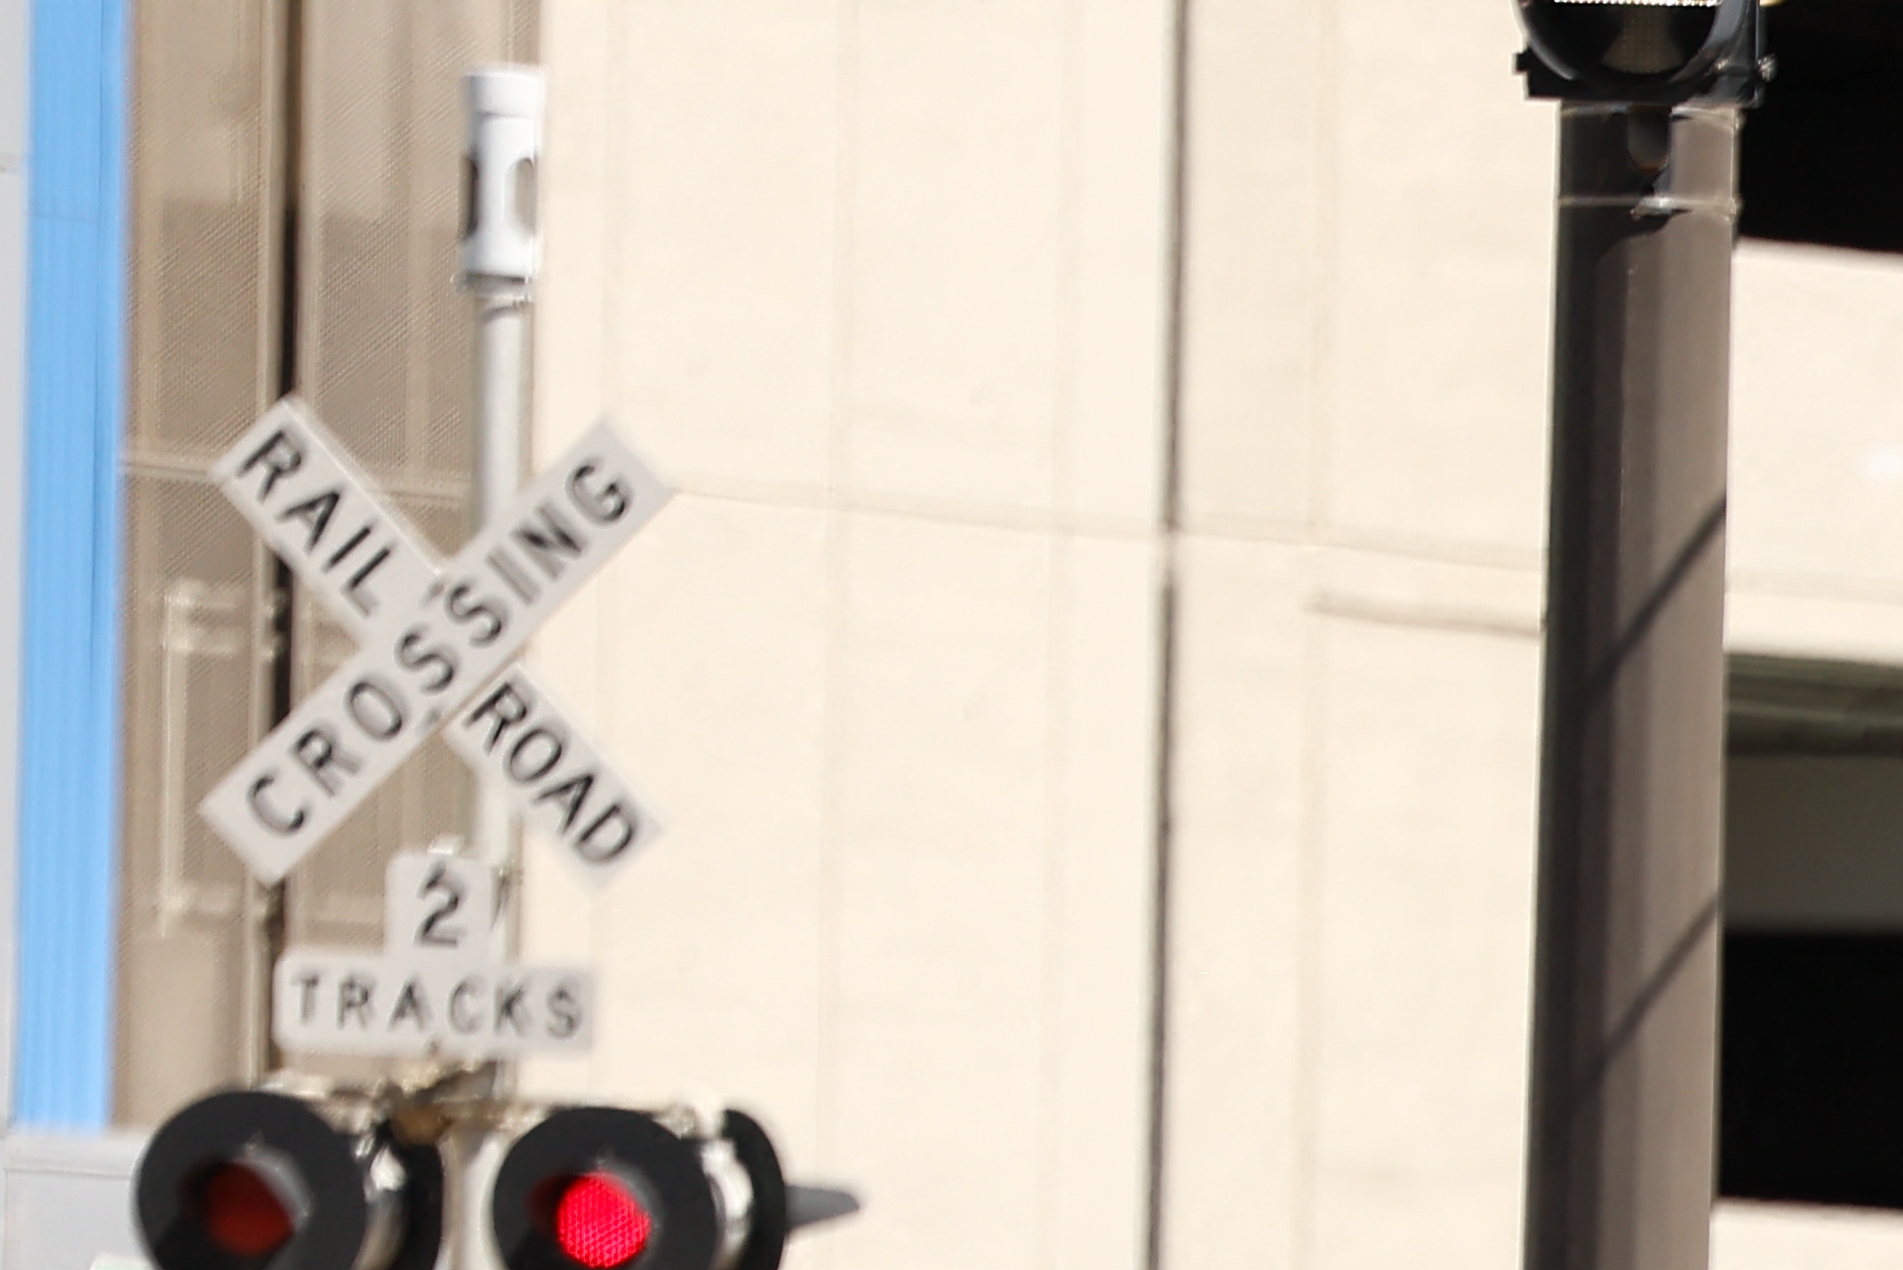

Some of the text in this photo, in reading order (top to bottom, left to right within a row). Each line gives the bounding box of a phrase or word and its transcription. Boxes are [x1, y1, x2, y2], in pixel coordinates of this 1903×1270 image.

[236, 430, 638, 865] RAIL ROAD
[246, 459, 633, 837] CROSSING
[291, 972, 583, 1039] TRACKS
[416, 860, 468, 947] 2
